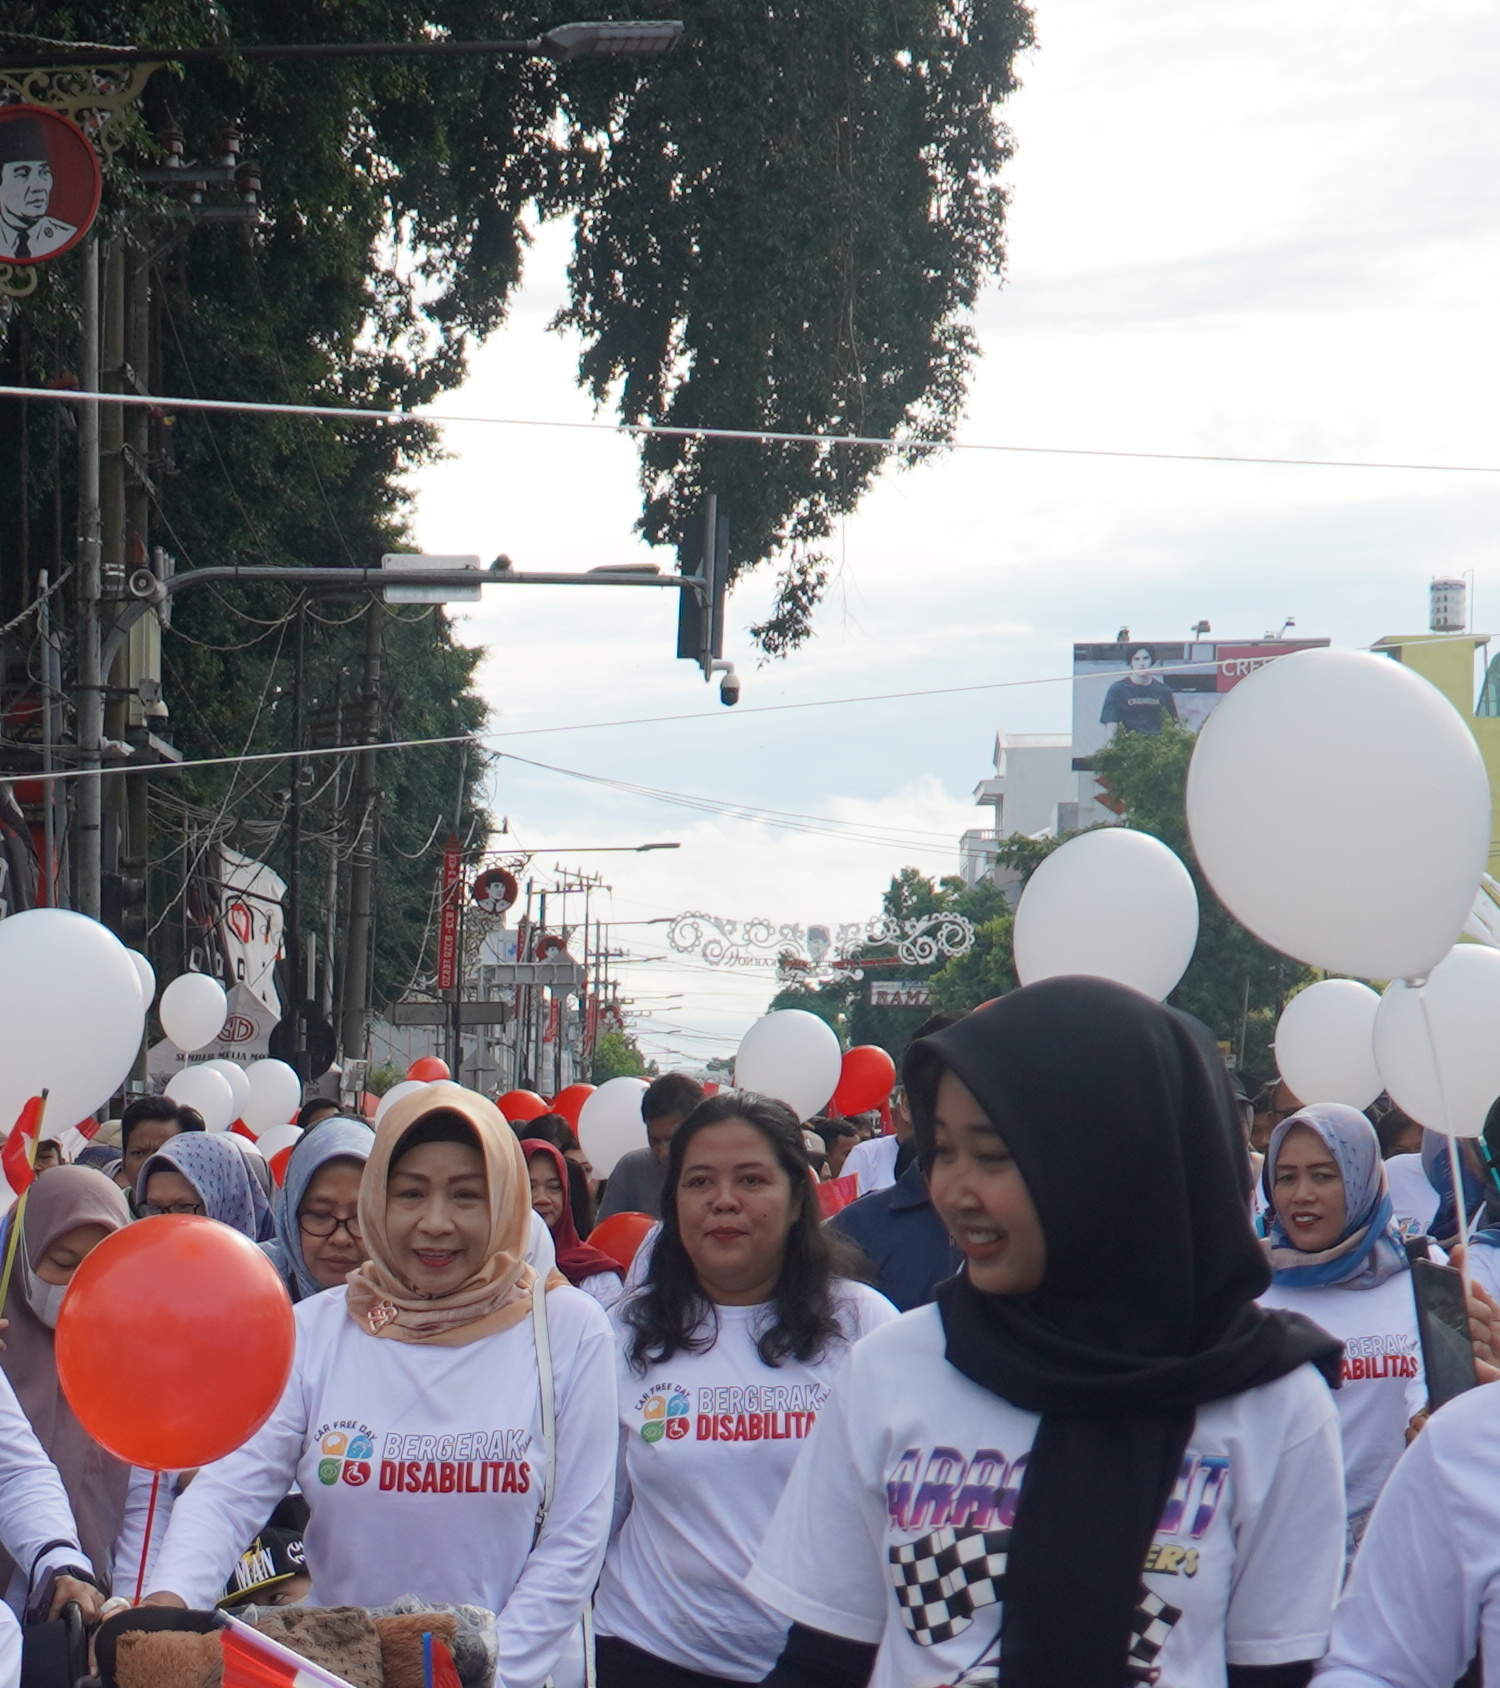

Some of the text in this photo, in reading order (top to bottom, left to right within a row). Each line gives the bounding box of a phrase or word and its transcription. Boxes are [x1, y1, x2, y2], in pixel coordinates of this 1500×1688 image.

[697, 1384, 823, 1414] BERGERAK
[696, 1409, 818, 1442] DISABILITA
[383, 1427, 525, 1462] BERGERAK
[379, 1461, 531, 1495] DISABILITAS
